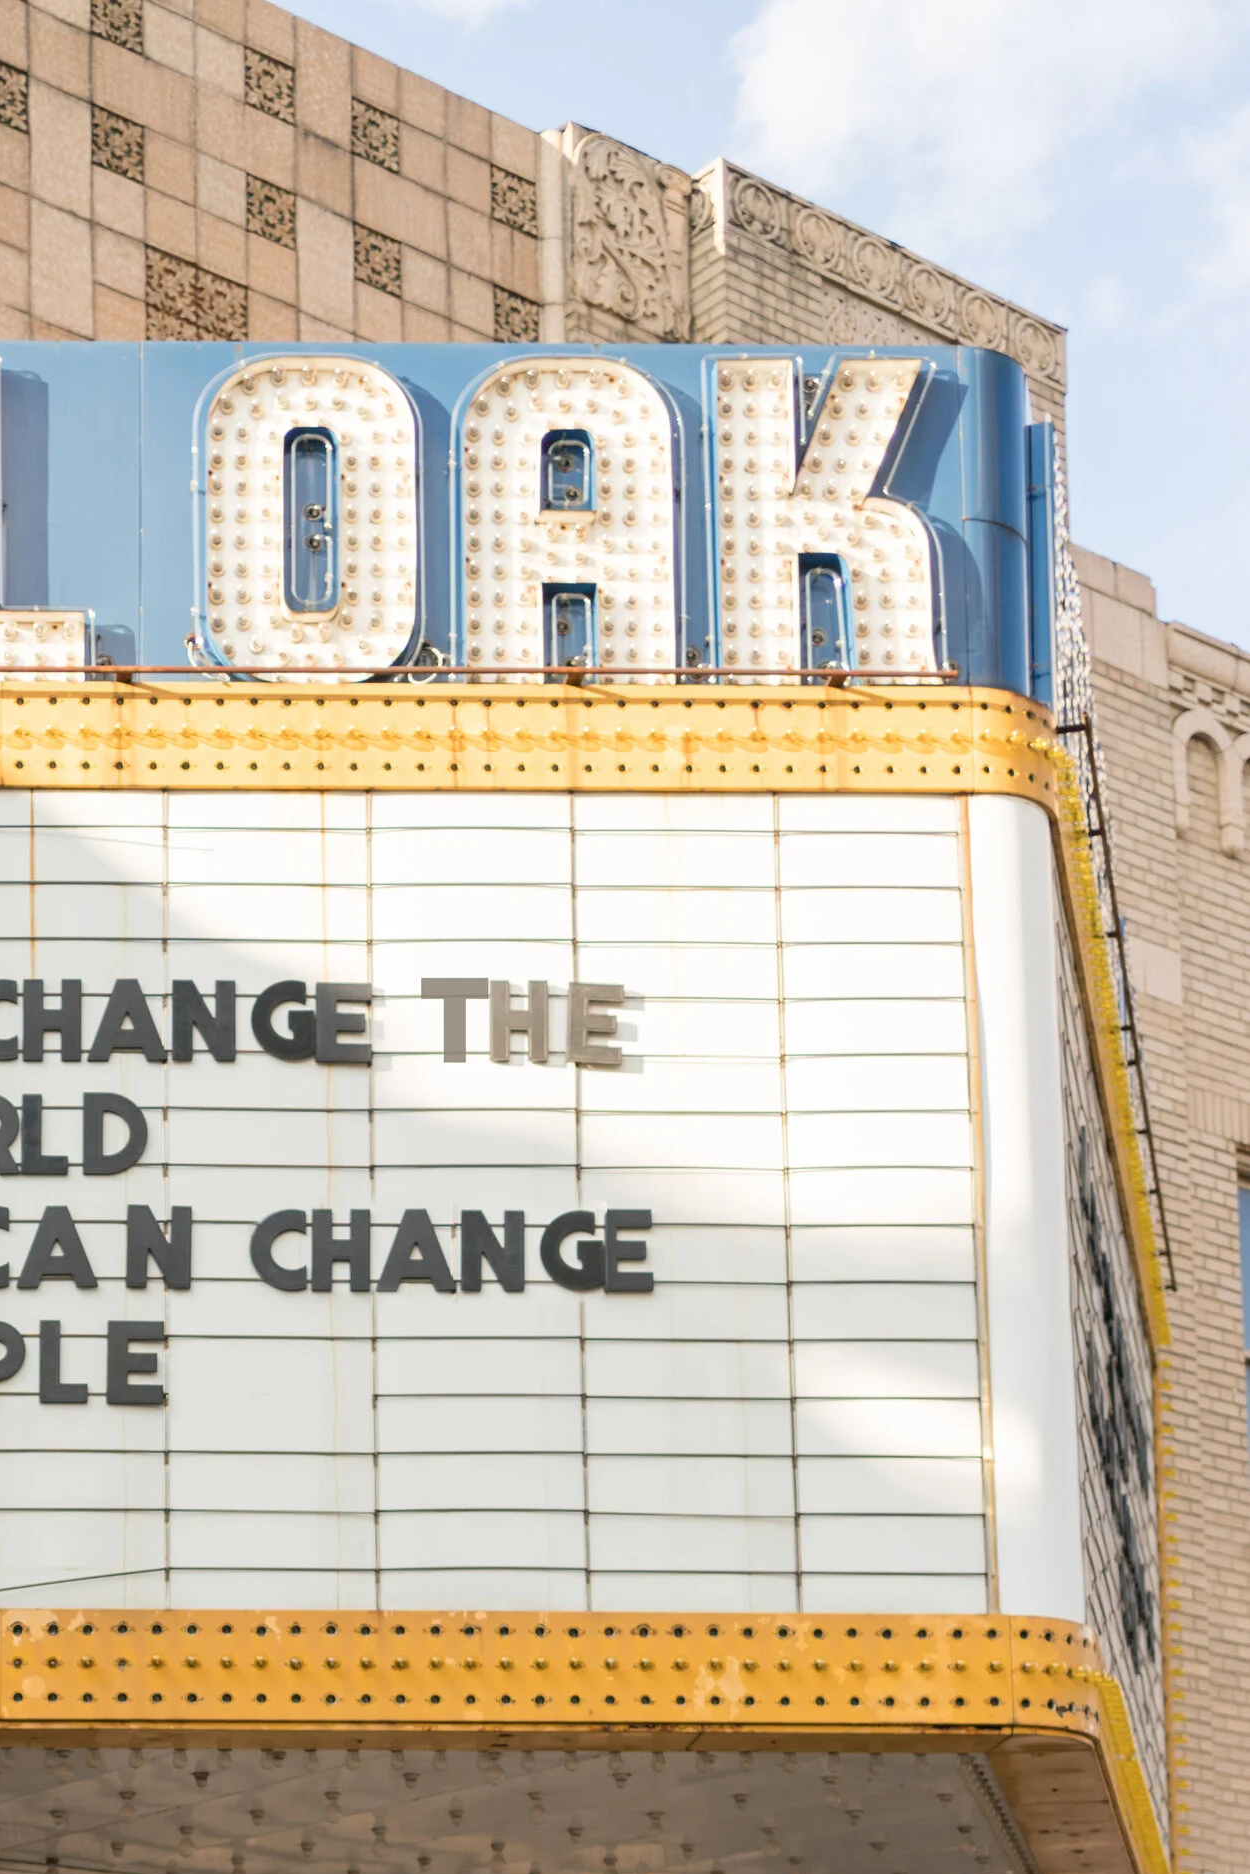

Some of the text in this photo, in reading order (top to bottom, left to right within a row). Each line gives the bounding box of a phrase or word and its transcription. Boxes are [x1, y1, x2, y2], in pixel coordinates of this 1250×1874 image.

[200, 352, 947, 687] OAK
[421, 977, 626, 1067] THE
[250, 1208, 655, 1294] CHANGE
